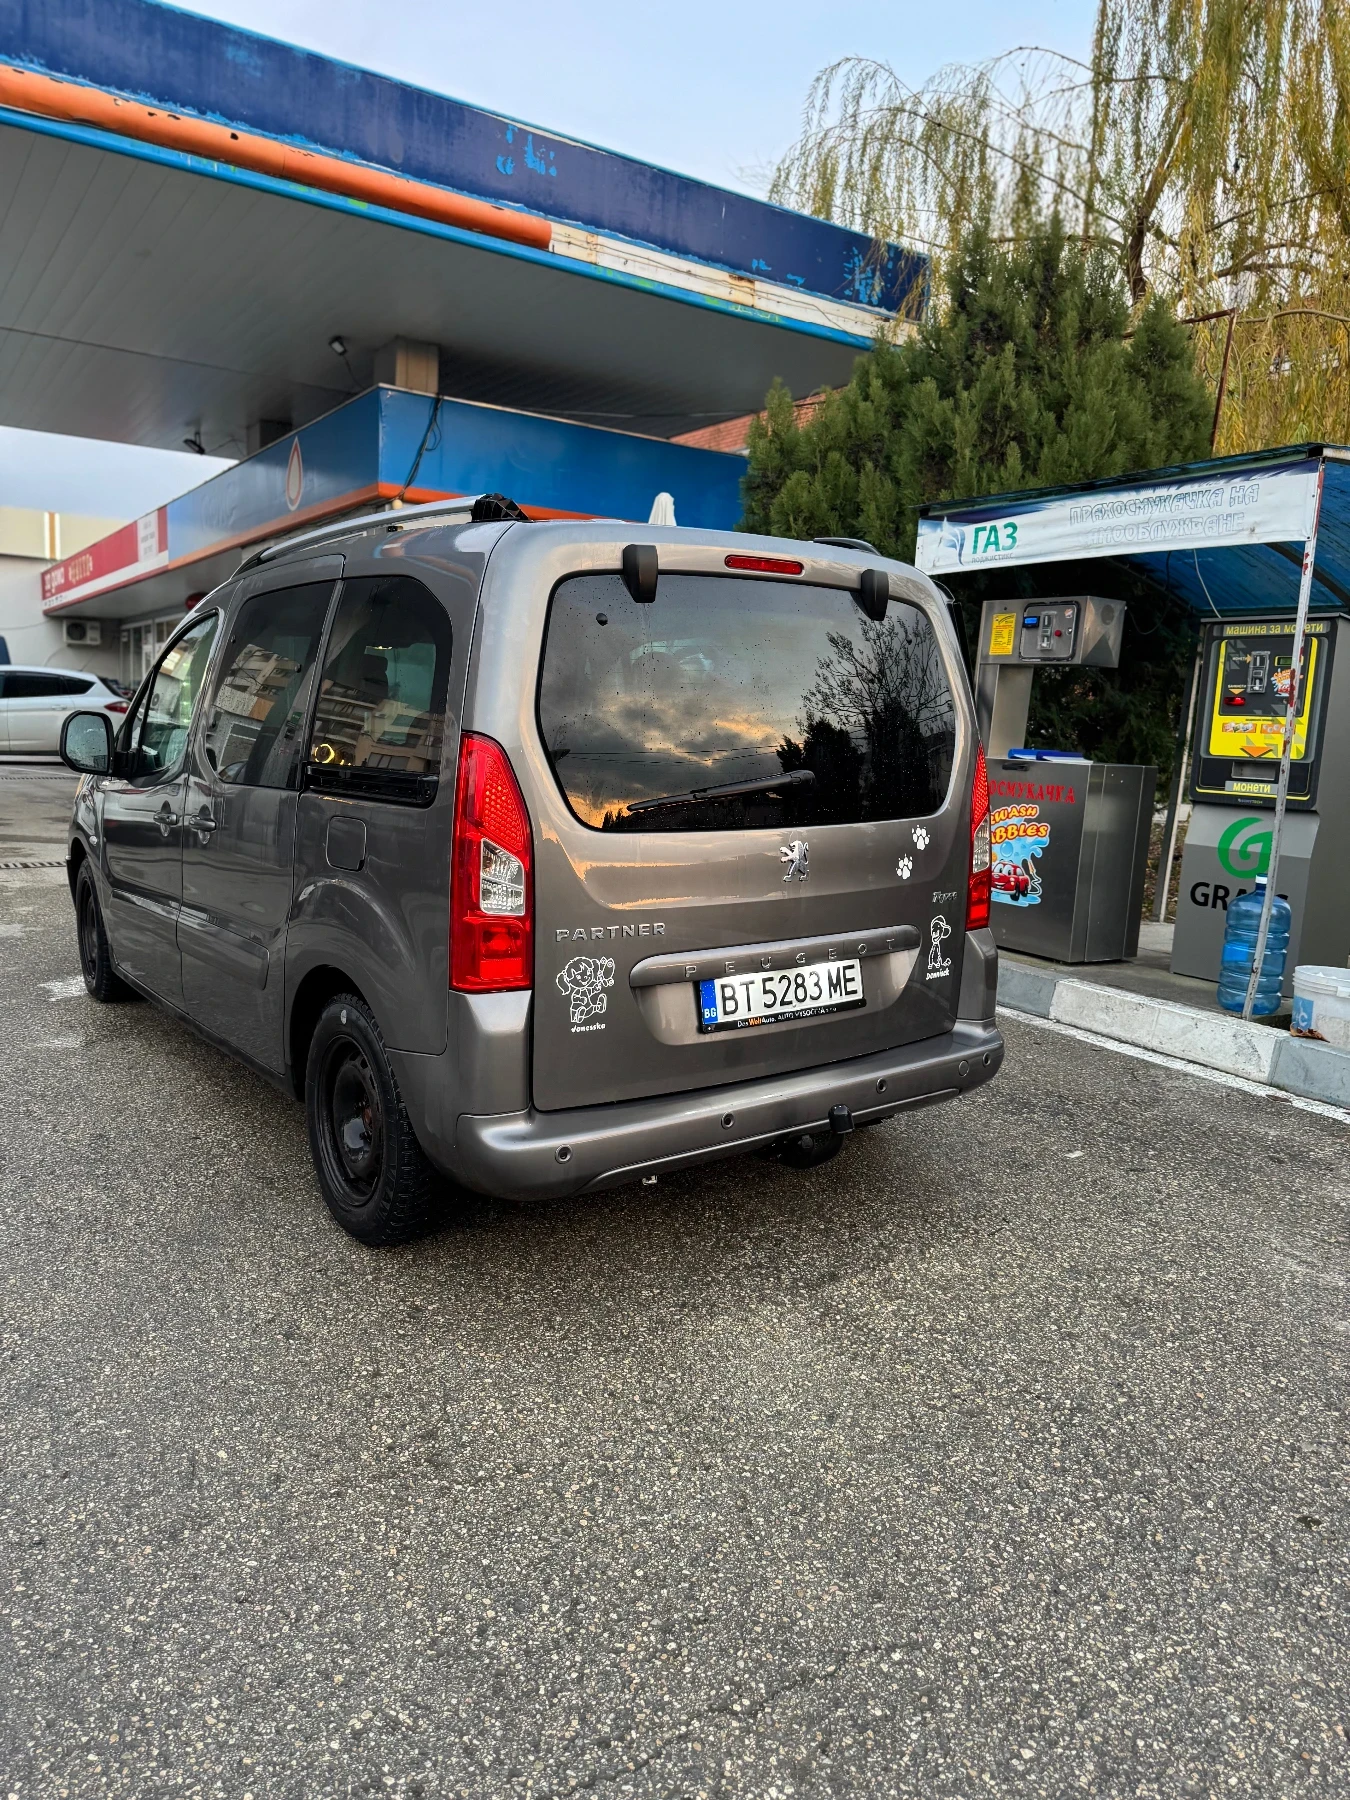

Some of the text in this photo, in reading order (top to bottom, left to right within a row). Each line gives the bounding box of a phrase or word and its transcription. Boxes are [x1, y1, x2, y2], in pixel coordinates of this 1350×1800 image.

[1070, 484, 1260, 526] ПРАХОСМУКАЧКА НА
[972, 521, 1018, 554] ГАЗ
[1082, 512, 1245, 545] АМООБЛУЖВАНЕ
[1226, 622, 1323, 635] машина за моети
[989, 780, 1075, 804] ОСМУКАЧКА
[1233, 782, 1271, 793] монети
[556, 922, 666, 942] PARTNER
[684, 938, 895, 978] PEUGEOT
[761, 971, 823, 1008] 5283
[704, 1007, 717, 1019] BG
